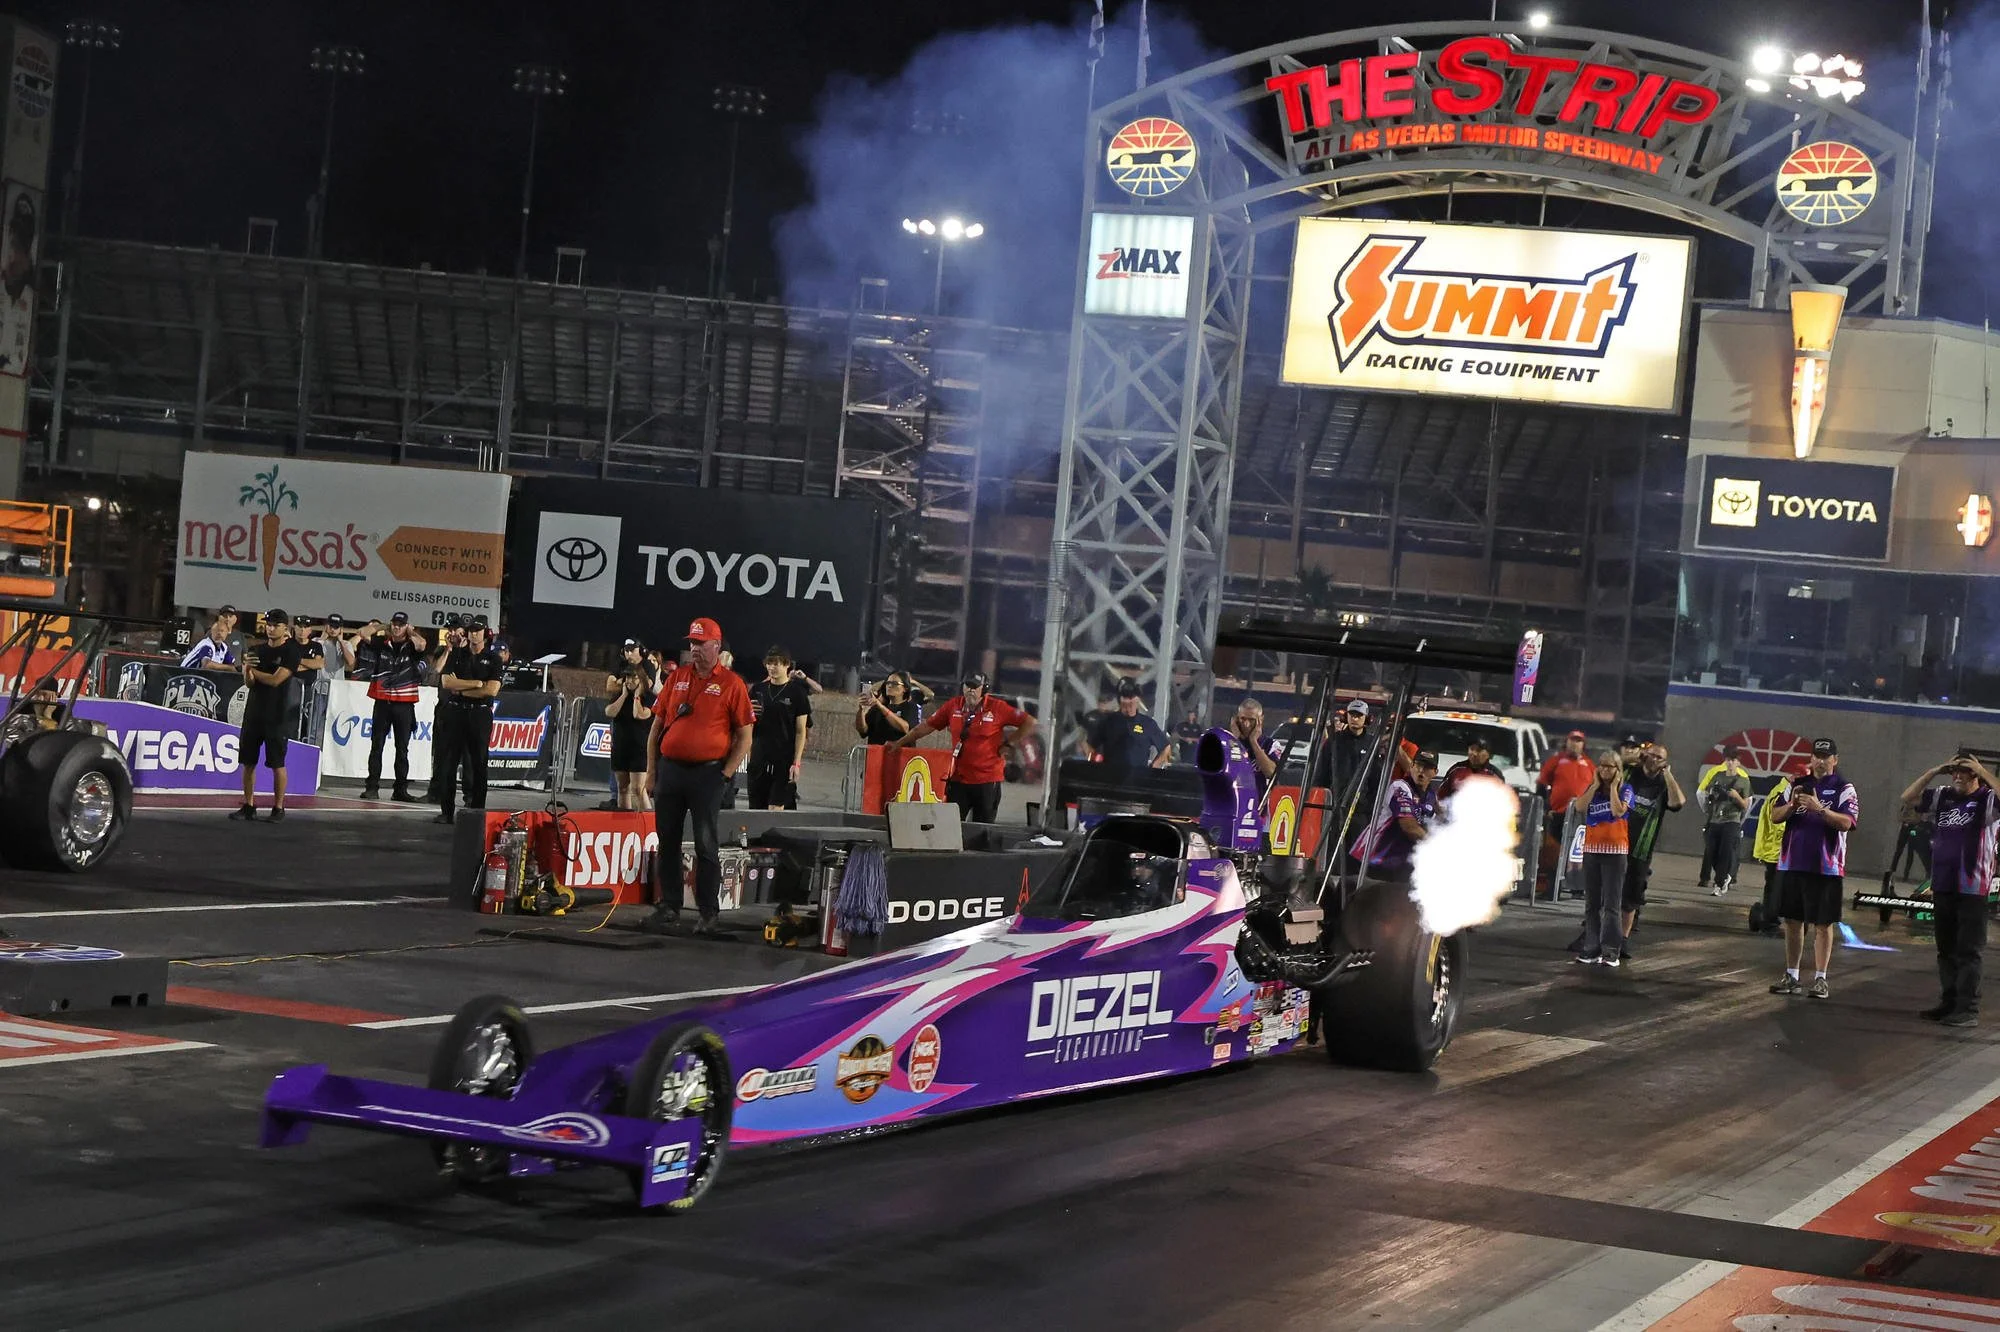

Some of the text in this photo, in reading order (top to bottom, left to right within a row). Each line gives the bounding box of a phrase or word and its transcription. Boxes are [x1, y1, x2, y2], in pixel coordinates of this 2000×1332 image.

[1265, 36, 1721, 138] THE STRIP
[1305, 123, 1665, 174] AT LAS VEGAS MOTOR SPEEDWAY
[1365, 353, 1600, 383] RACING EQUIPMENT
[1767, 494, 1878, 523] TOYOTA
[395, 543, 492, 559] CONNECT WITH
[413, 559, 490, 574] YOUR FOOD.
[638, 545, 843, 602] TOYOTA
[372, 588, 490, 609] @MELISSASPRODUCE
[178, 631, 189, 643] 52
[164, 684, 219, 717] PLAY
[107, 730, 240, 773] VEGAS
[887, 896, 1004, 923] DODGE
[1027, 970, 1174, 1042] DIEZEL
[1054, 1029, 1144, 1063] EXCAVATING
